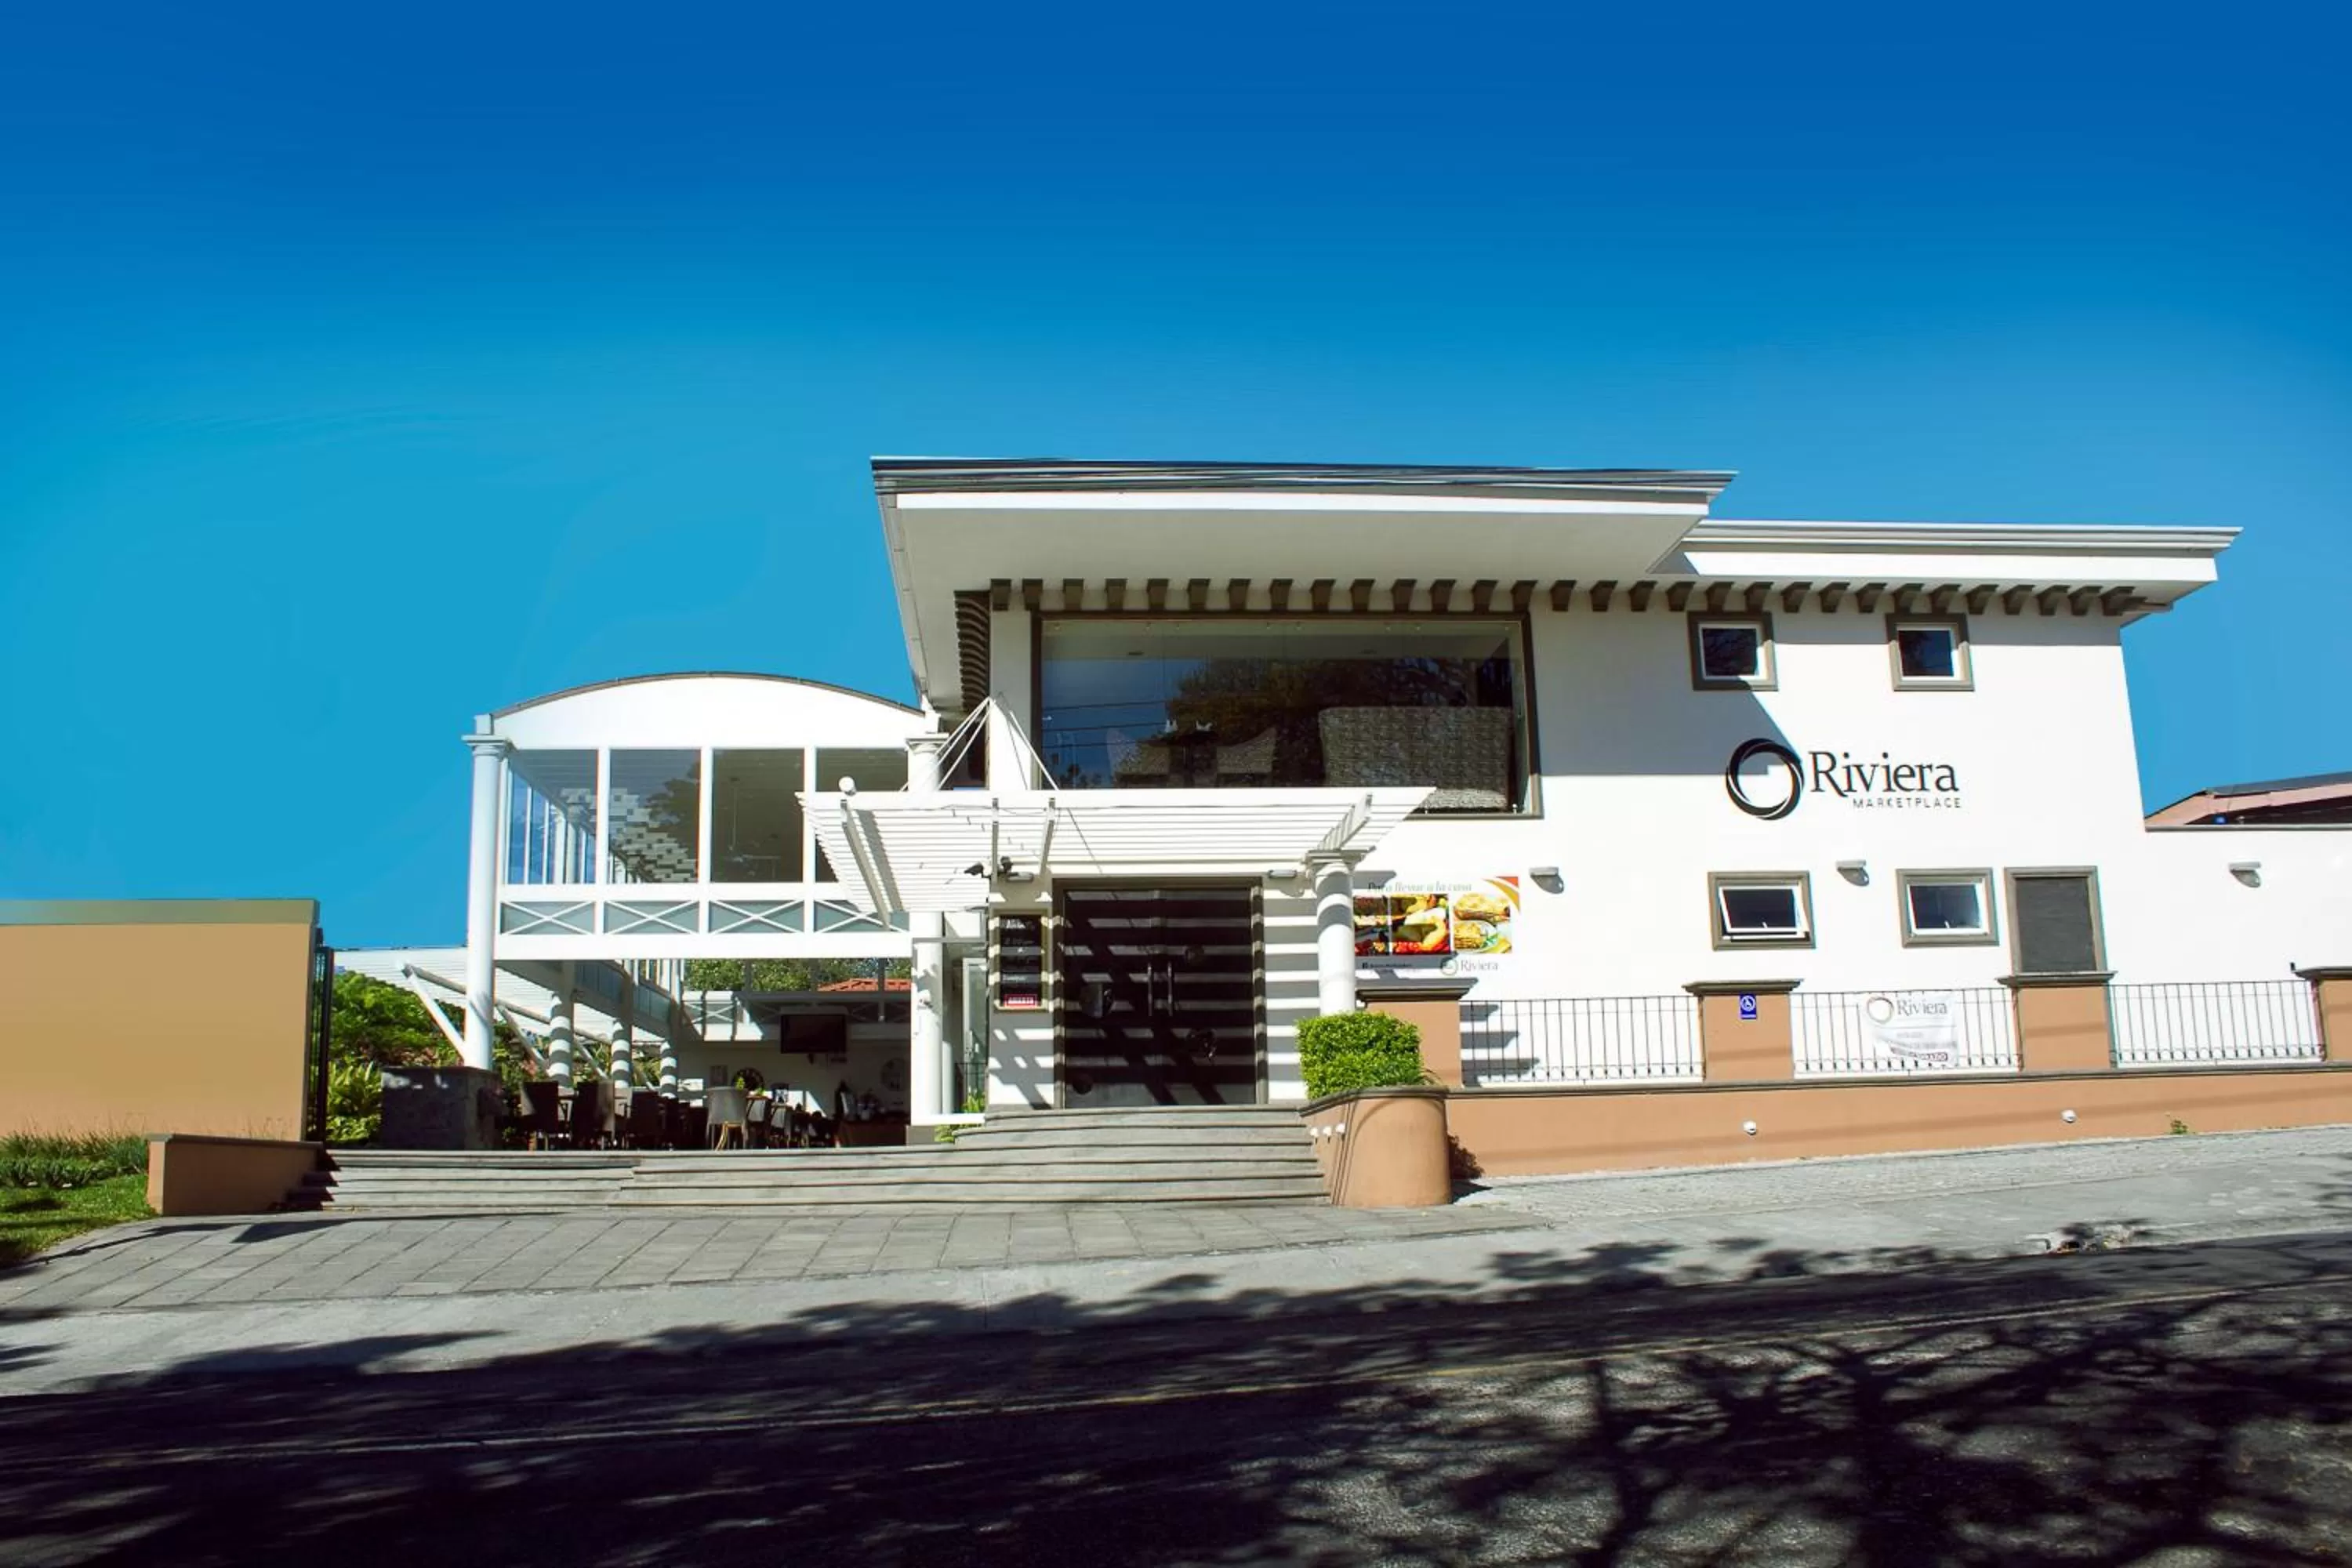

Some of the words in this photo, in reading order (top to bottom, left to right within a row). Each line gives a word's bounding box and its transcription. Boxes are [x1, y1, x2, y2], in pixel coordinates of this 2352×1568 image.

[1809, 750, 1959, 798] Riviera
[1852, 798, 1961, 808] MARKETPLACE
[1461, 960, 1498, 972] Riviera
[1896, 1000, 1947, 1016] Riviera
